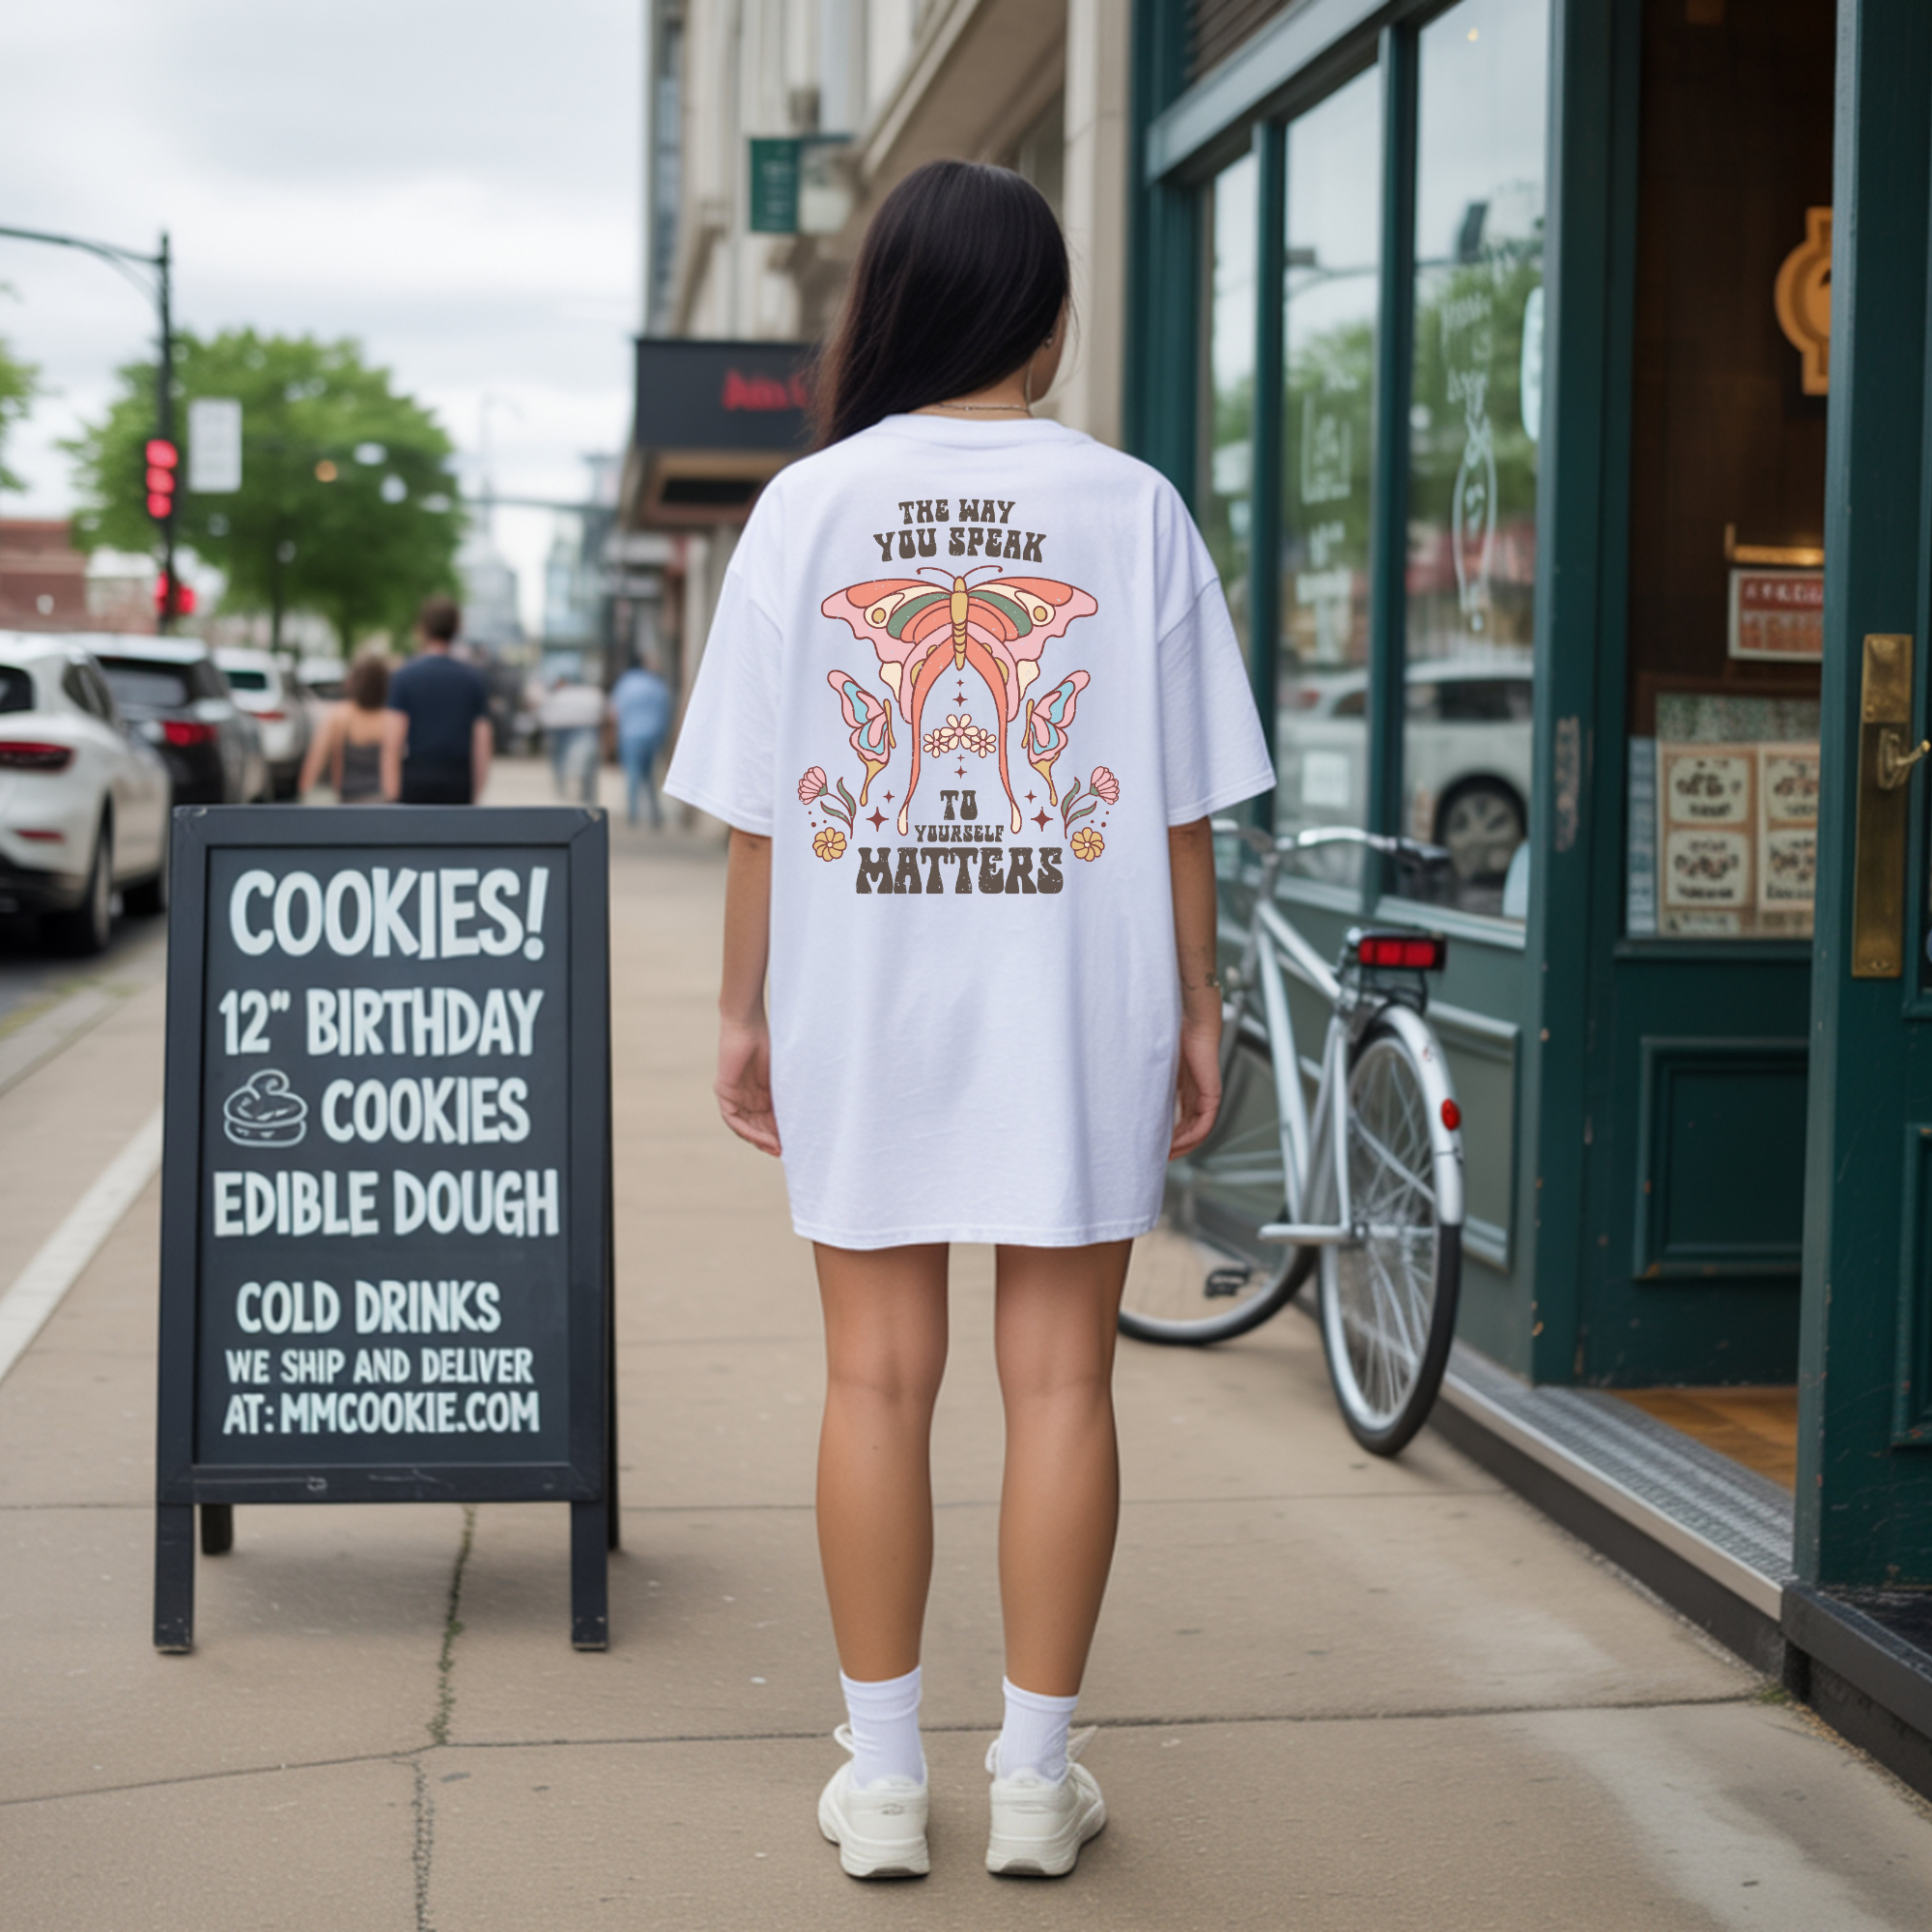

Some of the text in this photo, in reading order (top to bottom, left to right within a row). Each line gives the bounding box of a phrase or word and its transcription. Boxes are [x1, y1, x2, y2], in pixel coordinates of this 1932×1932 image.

[898, 498, 1016, 525] THE WAY
[873, 526, 1047, 563] YOU SPEAK
[940, 790, 979, 821] TO
[915, 825, 1005, 842] YOURSELF
[856, 847, 1064, 895] MATTERS
[229, 867, 550, 961] COOKIES!
[218, 987, 545, 1057] 12" BIRTHDAY
[321, 1076, 531, 1146] COOKIES
[213, 1168, 559, 1238] EDIBLE DOUGH
[236, 1280, 501, 1334] COLD DRINKS
[225, 1347, 534, 1384] WE SHIP AND DELIVER
[280, 1390, 540, 1435] MMCOOKIE.COM
